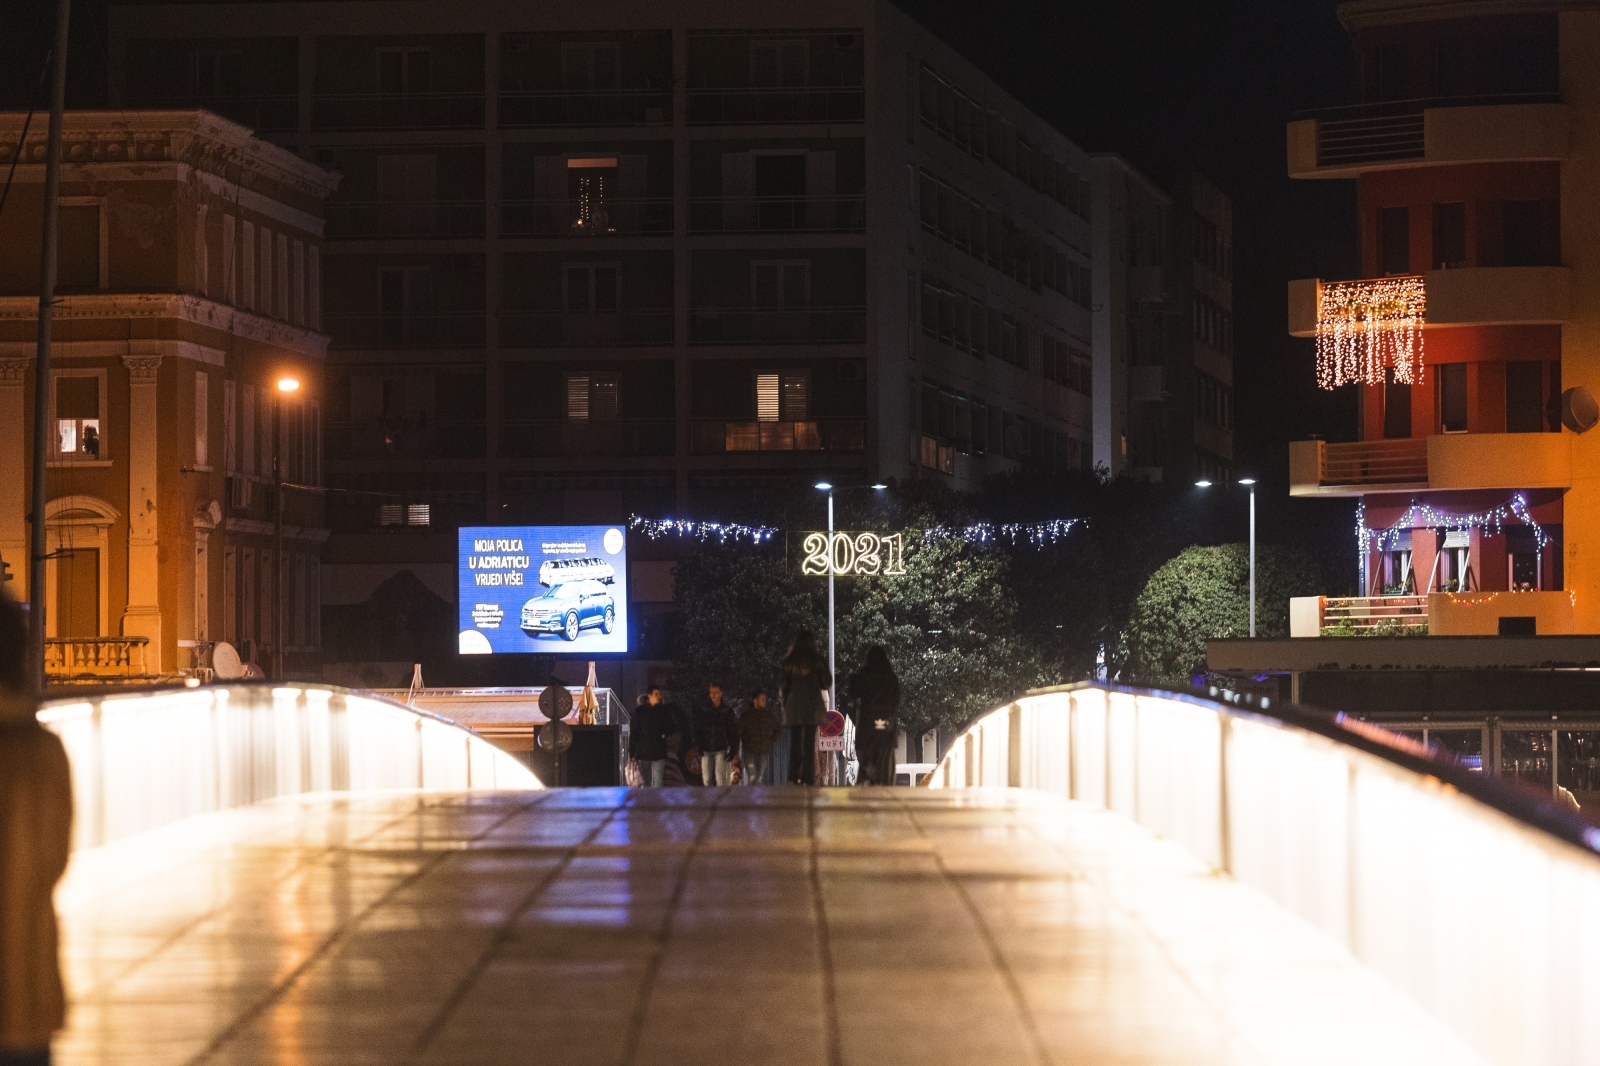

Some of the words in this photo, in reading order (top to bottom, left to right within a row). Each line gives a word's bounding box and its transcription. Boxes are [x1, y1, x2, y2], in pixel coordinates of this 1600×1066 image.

[475, 540, 494, 552] MOJA
[496, 540, 523, 552] POLICA
[802, 532, 907, 575] 2021
[469, 556, 477, 569] U
[478, 556, 529, 569] ADRIATICU
[475, 573, 503, 586] VRIJEDI
[504, 570, 523, 586] VIŠE!
